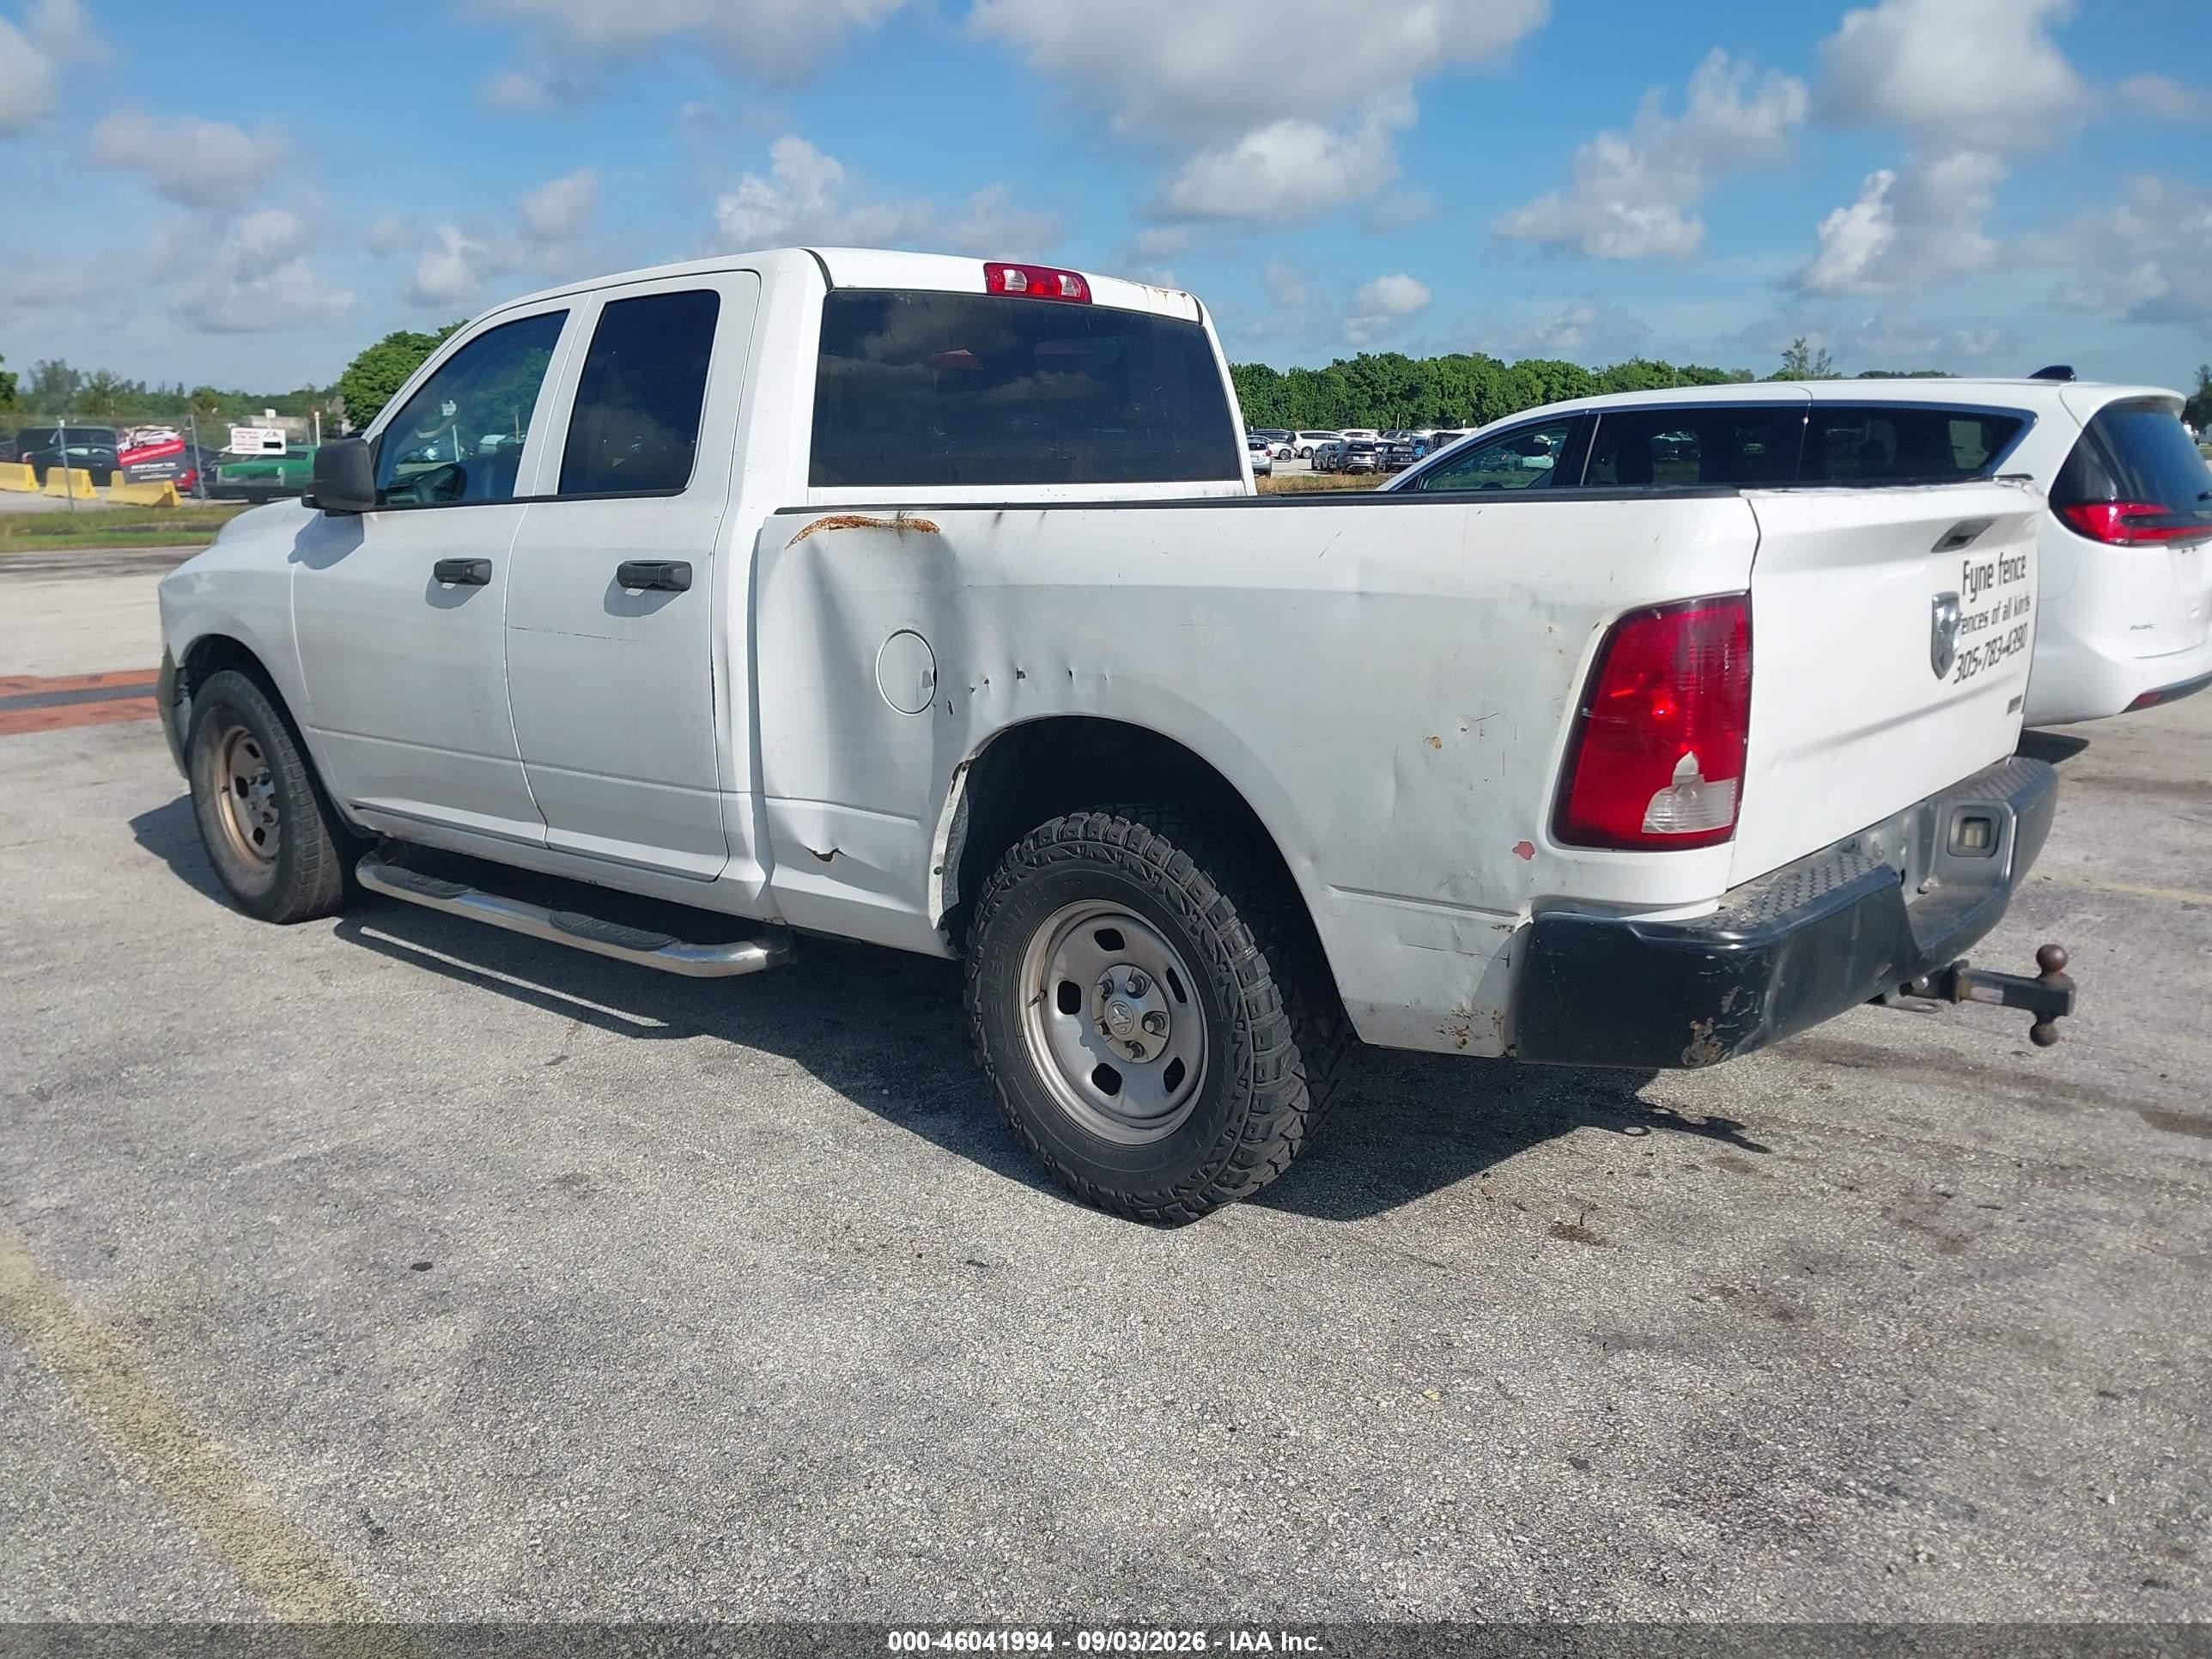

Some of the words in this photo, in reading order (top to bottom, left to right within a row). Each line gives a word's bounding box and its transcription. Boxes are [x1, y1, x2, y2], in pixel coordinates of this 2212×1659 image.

[1963, 561, 1994, 603] Fyne
[1999, 552, 2026, 586] fence
[1991, 601, 2001, 625] of
